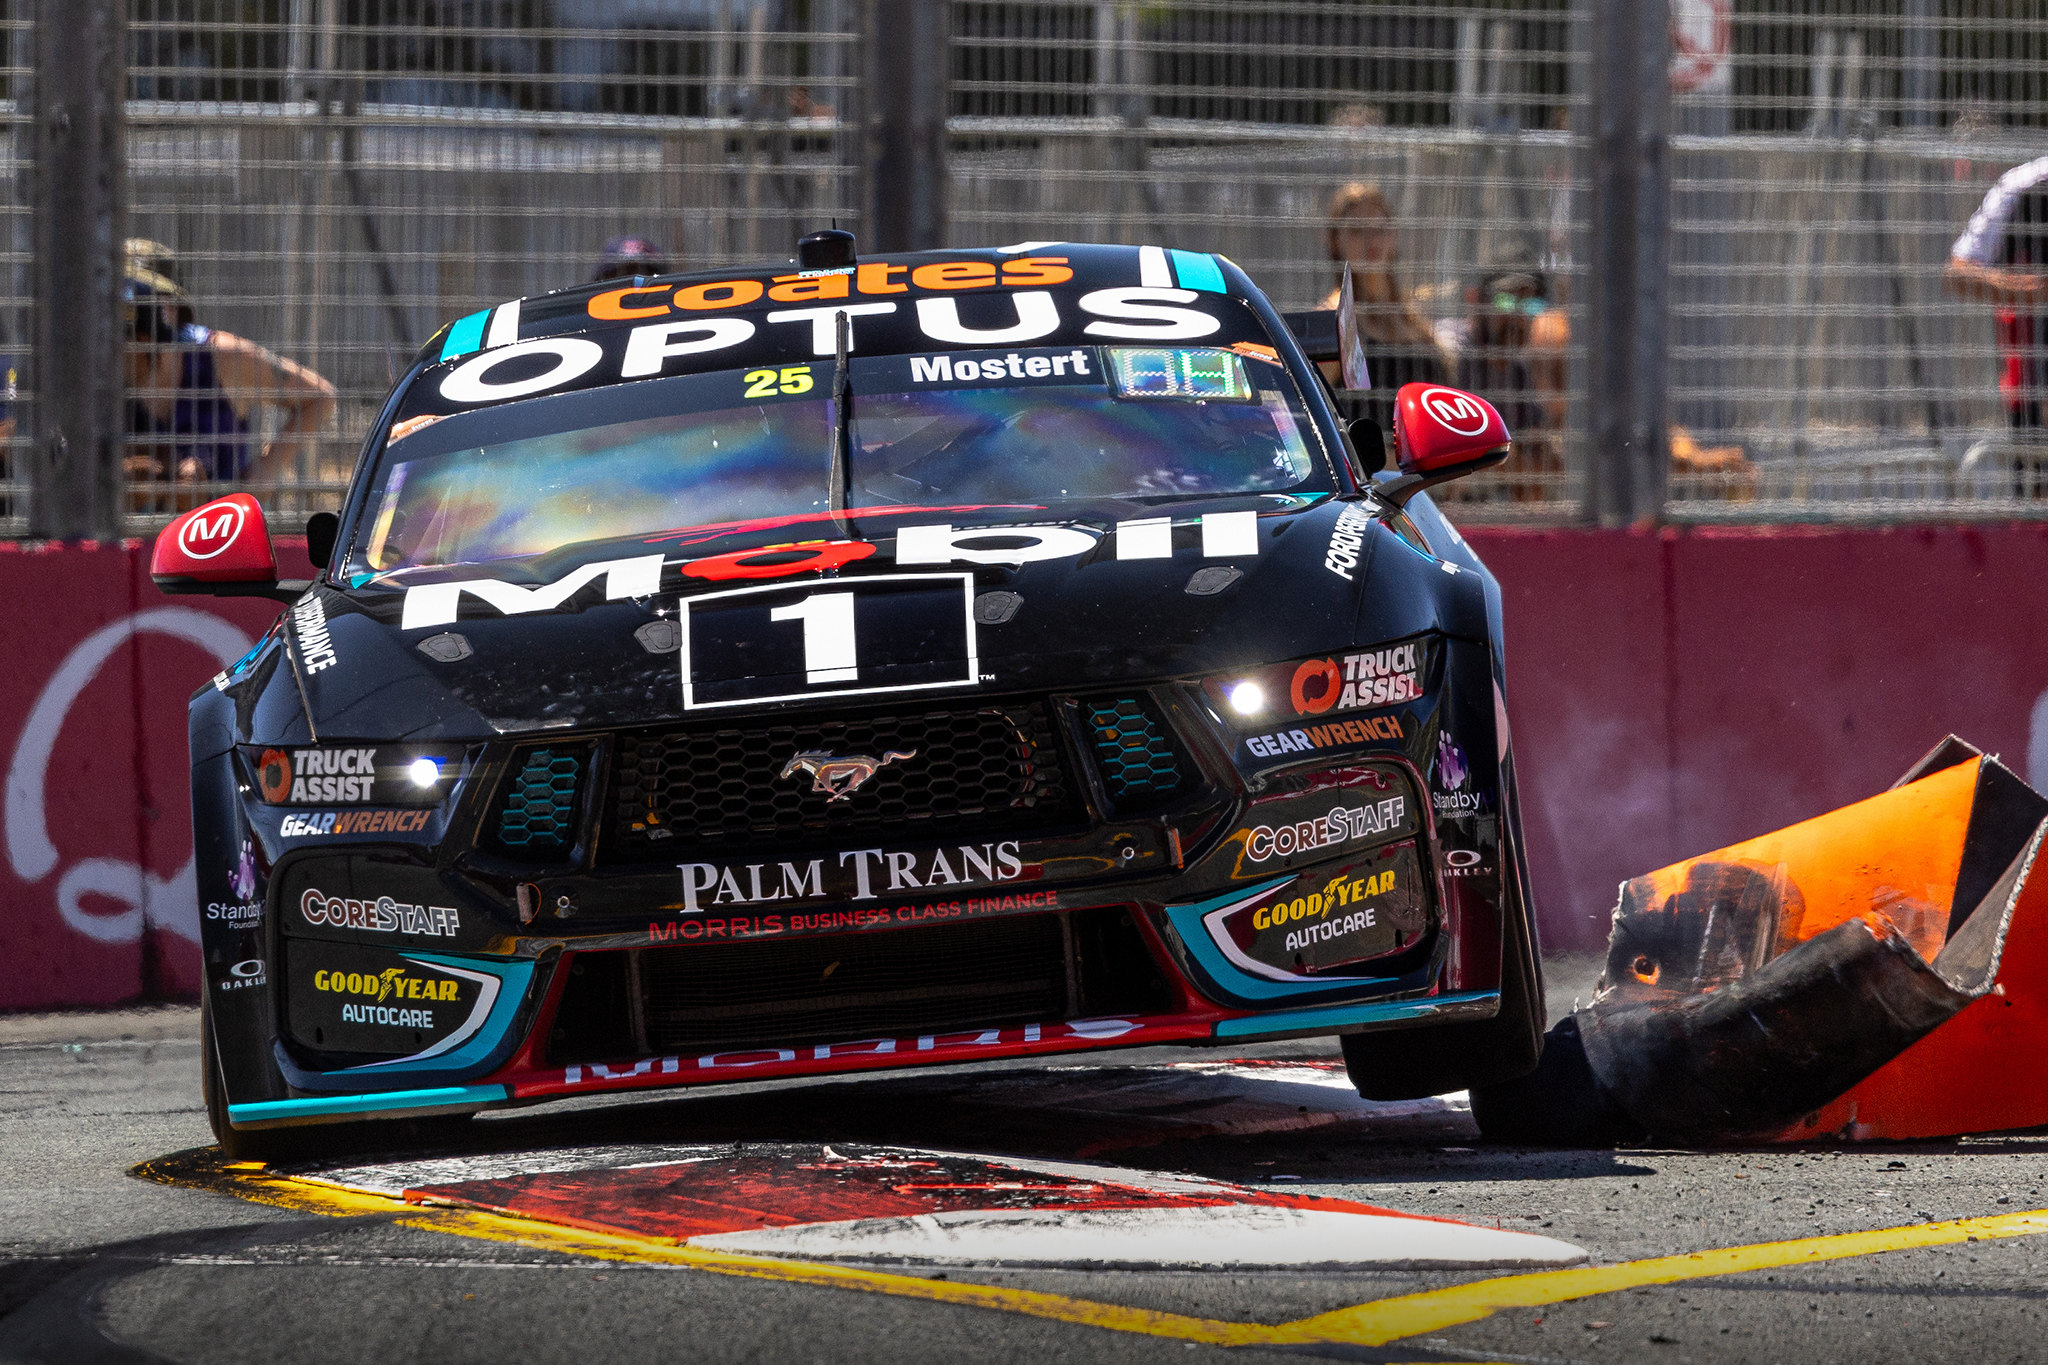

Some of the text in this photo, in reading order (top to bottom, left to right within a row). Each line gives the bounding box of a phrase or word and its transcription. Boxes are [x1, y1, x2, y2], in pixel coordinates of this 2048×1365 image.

[587, 255, 1074, 322] coates
[438, 285, 1222, 402] OPTUS
[743, 366, 814, 398] 25
[909, 350, 1091, 383] Mostert
[401, 510, 1259, 630] Mobil
[770, 592, 858, 684] 1
[1343, 644, 1415, 680] TRUCK
[1337, 673, 1416, 709] ASSIST
[1245, 715, 1404, 758] GEARWRENCH
[294, 748, 377, 776] TRUCK
[290, 776, 376, 801] ASSIST
[280, 810, 431, 837] GEARWRENCH
[677, 840, 1023, 914] PALM TRANS
[648, 889, 1059, 942] MORRIS BUSINESS CLASS FINANCE
[1252, 868, 1396, 931] GOODYEAR
[1285, 908, 1377, 952] AUTOCARE
[314, 968, 459, 1003] GOODYEAR
[342, 1003, 434, 1028] AUTOCARE
